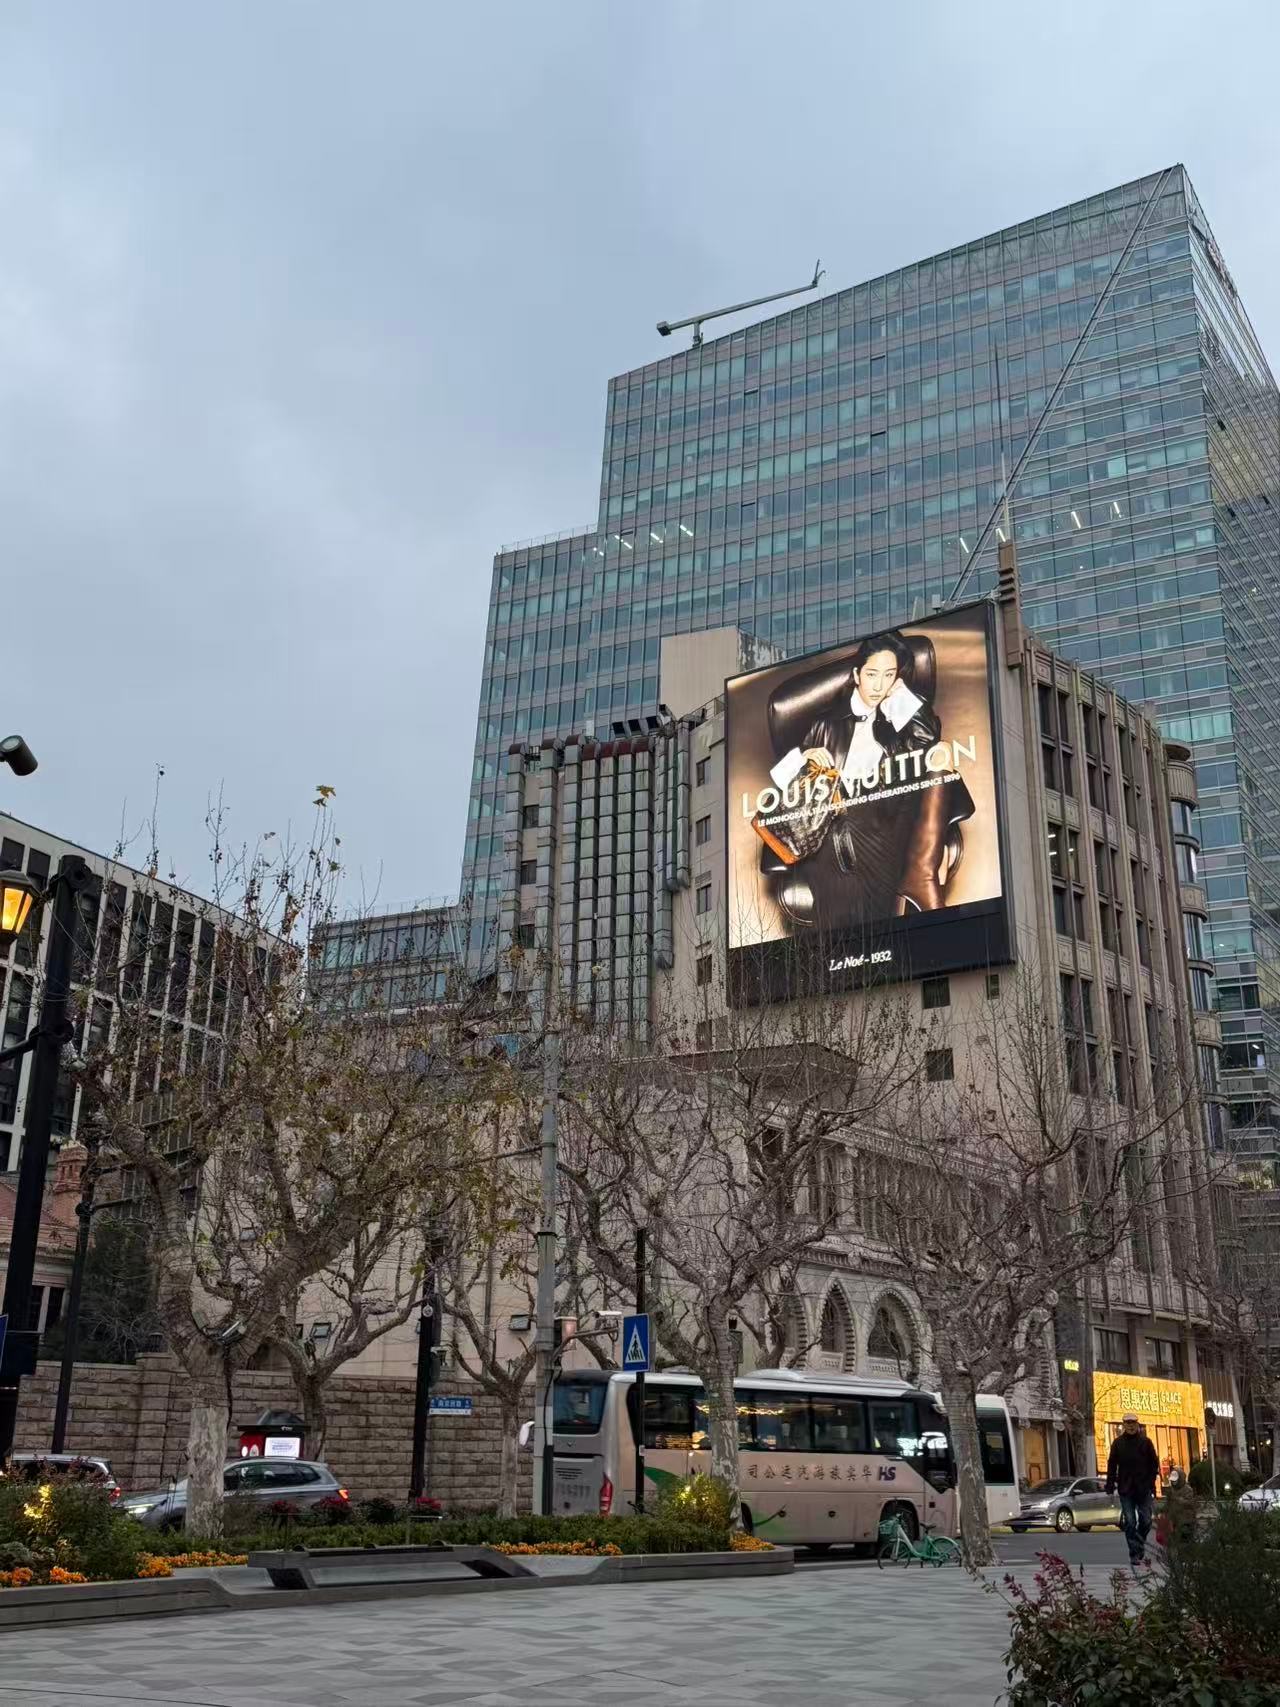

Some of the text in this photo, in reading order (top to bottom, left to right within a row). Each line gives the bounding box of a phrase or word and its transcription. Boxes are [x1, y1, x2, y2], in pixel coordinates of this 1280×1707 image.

[742, 735, 976, 818] LOUIS VUITTON
[757, 819, 766, 827] LE
[867, 782, 920, 802] GENERATIONS
[920, 776, 943, 789] SINCE
[829, 959, 843, 971] Le
[843, 954, 864, 969] Noé
[871, 950, 892, 964] 1932
[878, 1466, 897, 1481] HS
